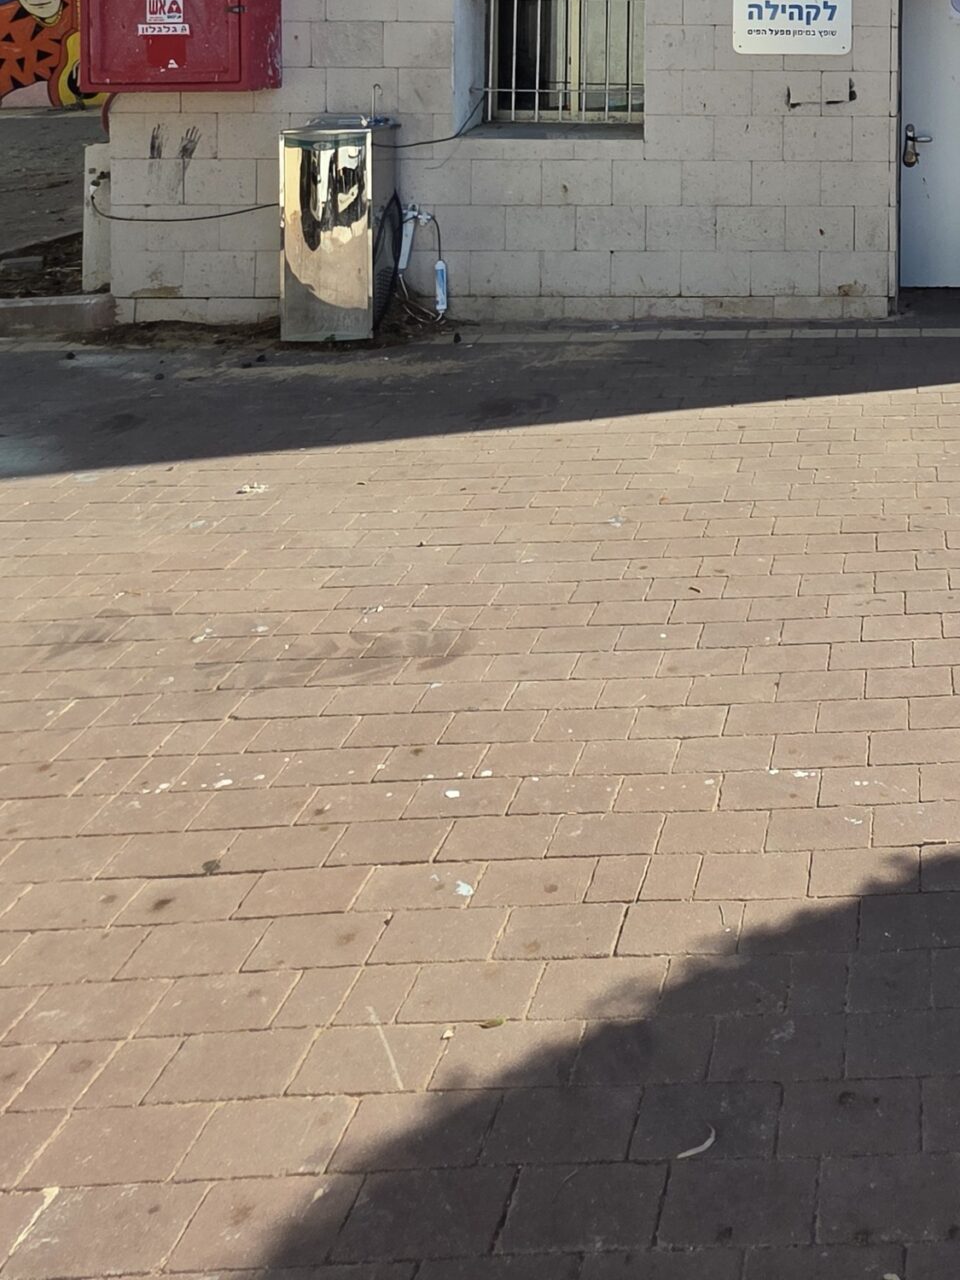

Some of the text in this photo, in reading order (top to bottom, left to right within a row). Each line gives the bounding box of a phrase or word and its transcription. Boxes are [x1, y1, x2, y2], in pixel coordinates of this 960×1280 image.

[148, 0, 167, 15] אש
[747, 0, 838, 26] לקהילה
[141, 25, 178, 34] גלגלון
[747, 28, 838, 38] שופץ במימון מפעל הפיס
